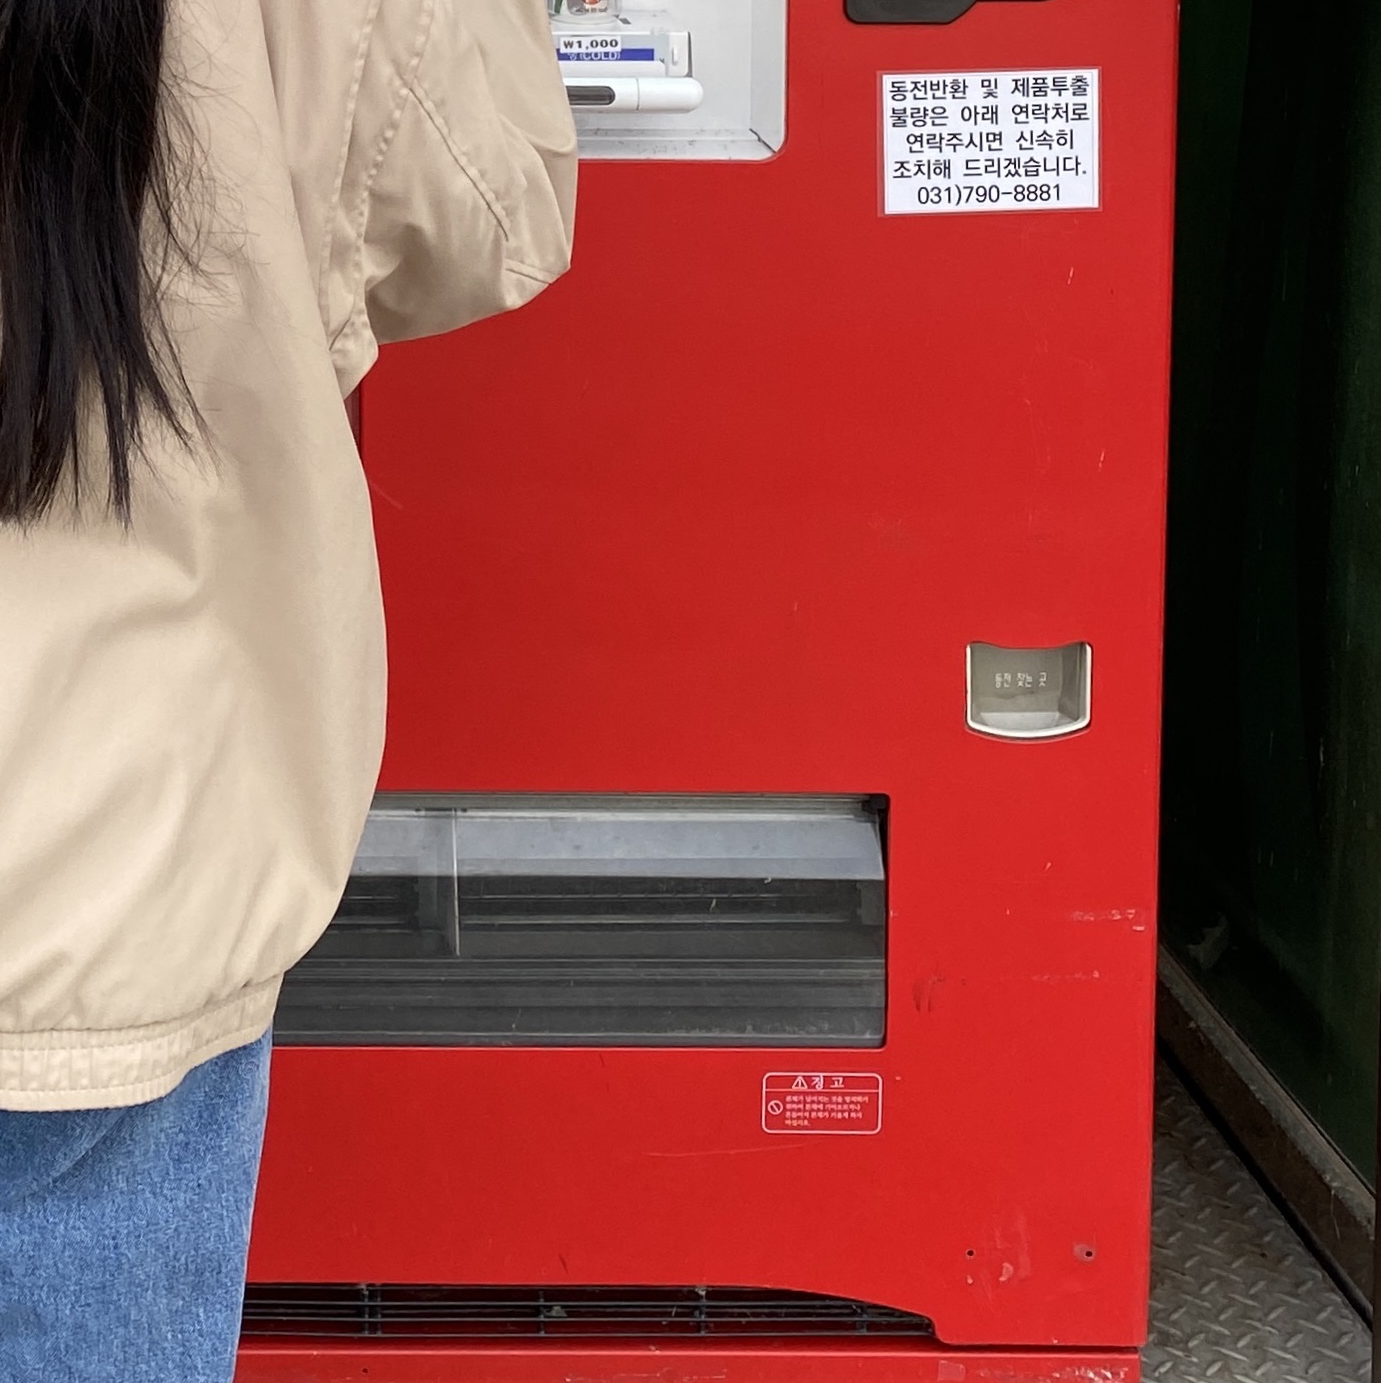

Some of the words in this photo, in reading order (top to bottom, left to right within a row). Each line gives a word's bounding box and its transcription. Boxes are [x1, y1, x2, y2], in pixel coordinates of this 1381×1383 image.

[563, 39, 618, 50] ₩1,000
[889, 79, 968, 101] 동전반환
[981, 78, 999, 98] 및
[1011, 75, 1090, 98] 제품투출
[890, 105, 949, 127] 불량은
[960, 104, 999, 126] 아래
[1011, 102, 1090, 124] 연락처로
[906, 130, 1003, 154] 연락주시면
[1015, 128, 1073, 151] 신속히
[892, 159, 951, 180] 조치해
[963, 155, 1087, 178] 드리겠습니다.
[917, 183, 1061, 206] 031)790-8881
[995, 672, 1011, 688] 동전
[1017, 672, 1032, 688] 찾는
[1038, 671, 1047, 687] 곳
